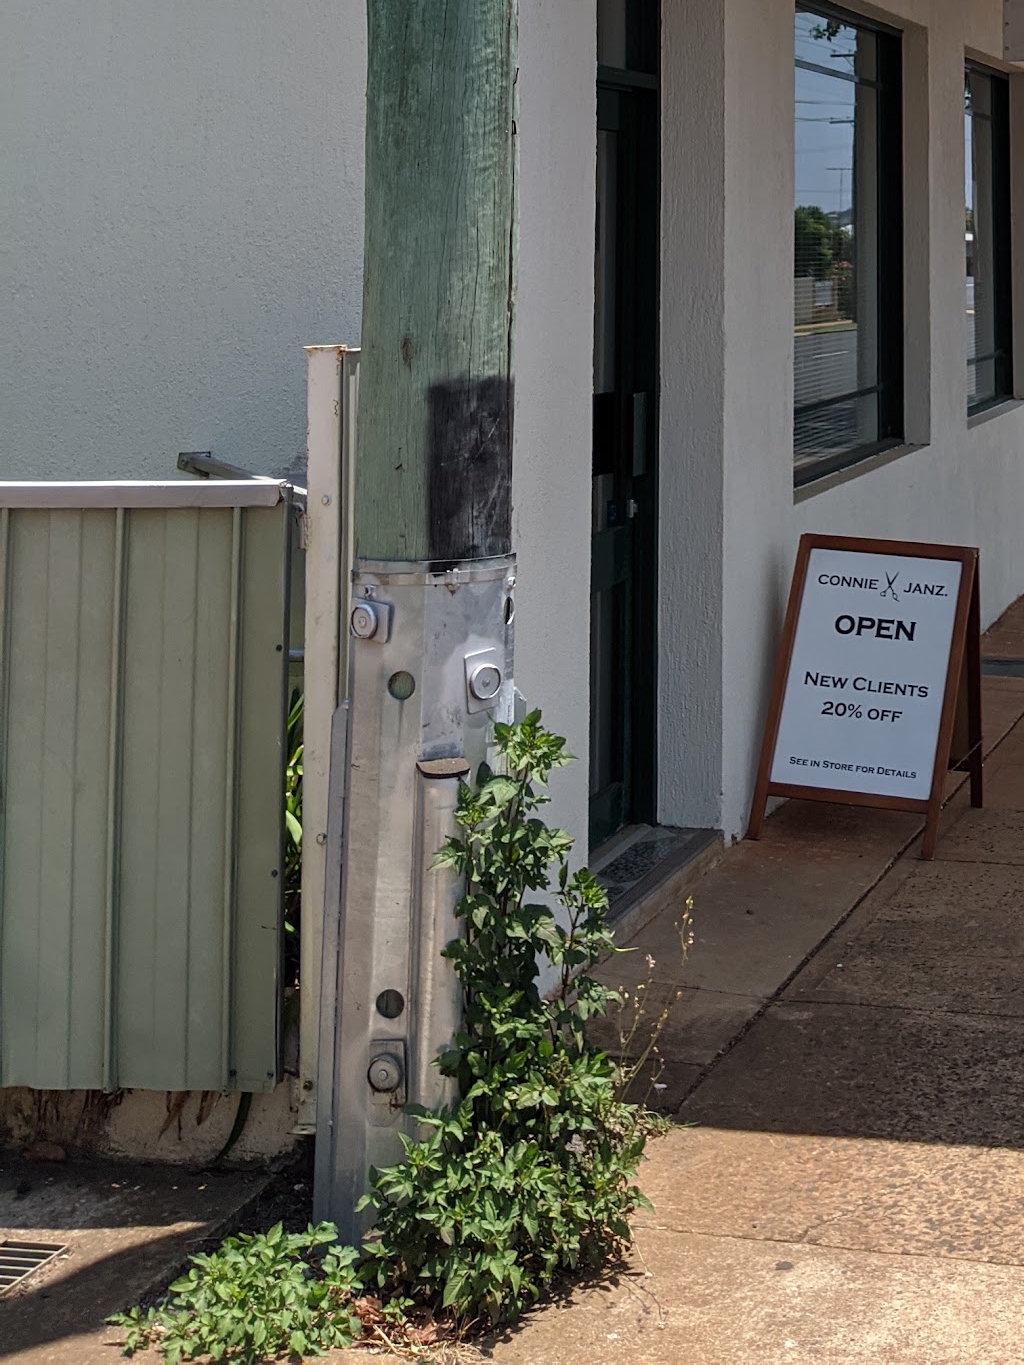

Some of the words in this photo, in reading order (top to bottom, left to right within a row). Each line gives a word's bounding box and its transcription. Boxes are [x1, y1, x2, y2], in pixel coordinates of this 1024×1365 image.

[818, 574, 880, 590] CONNIE
[834, 614, 917, 642] OPEN
[820, 701, 863, 719] 20%
[867, 708, 903, 723] OFF
